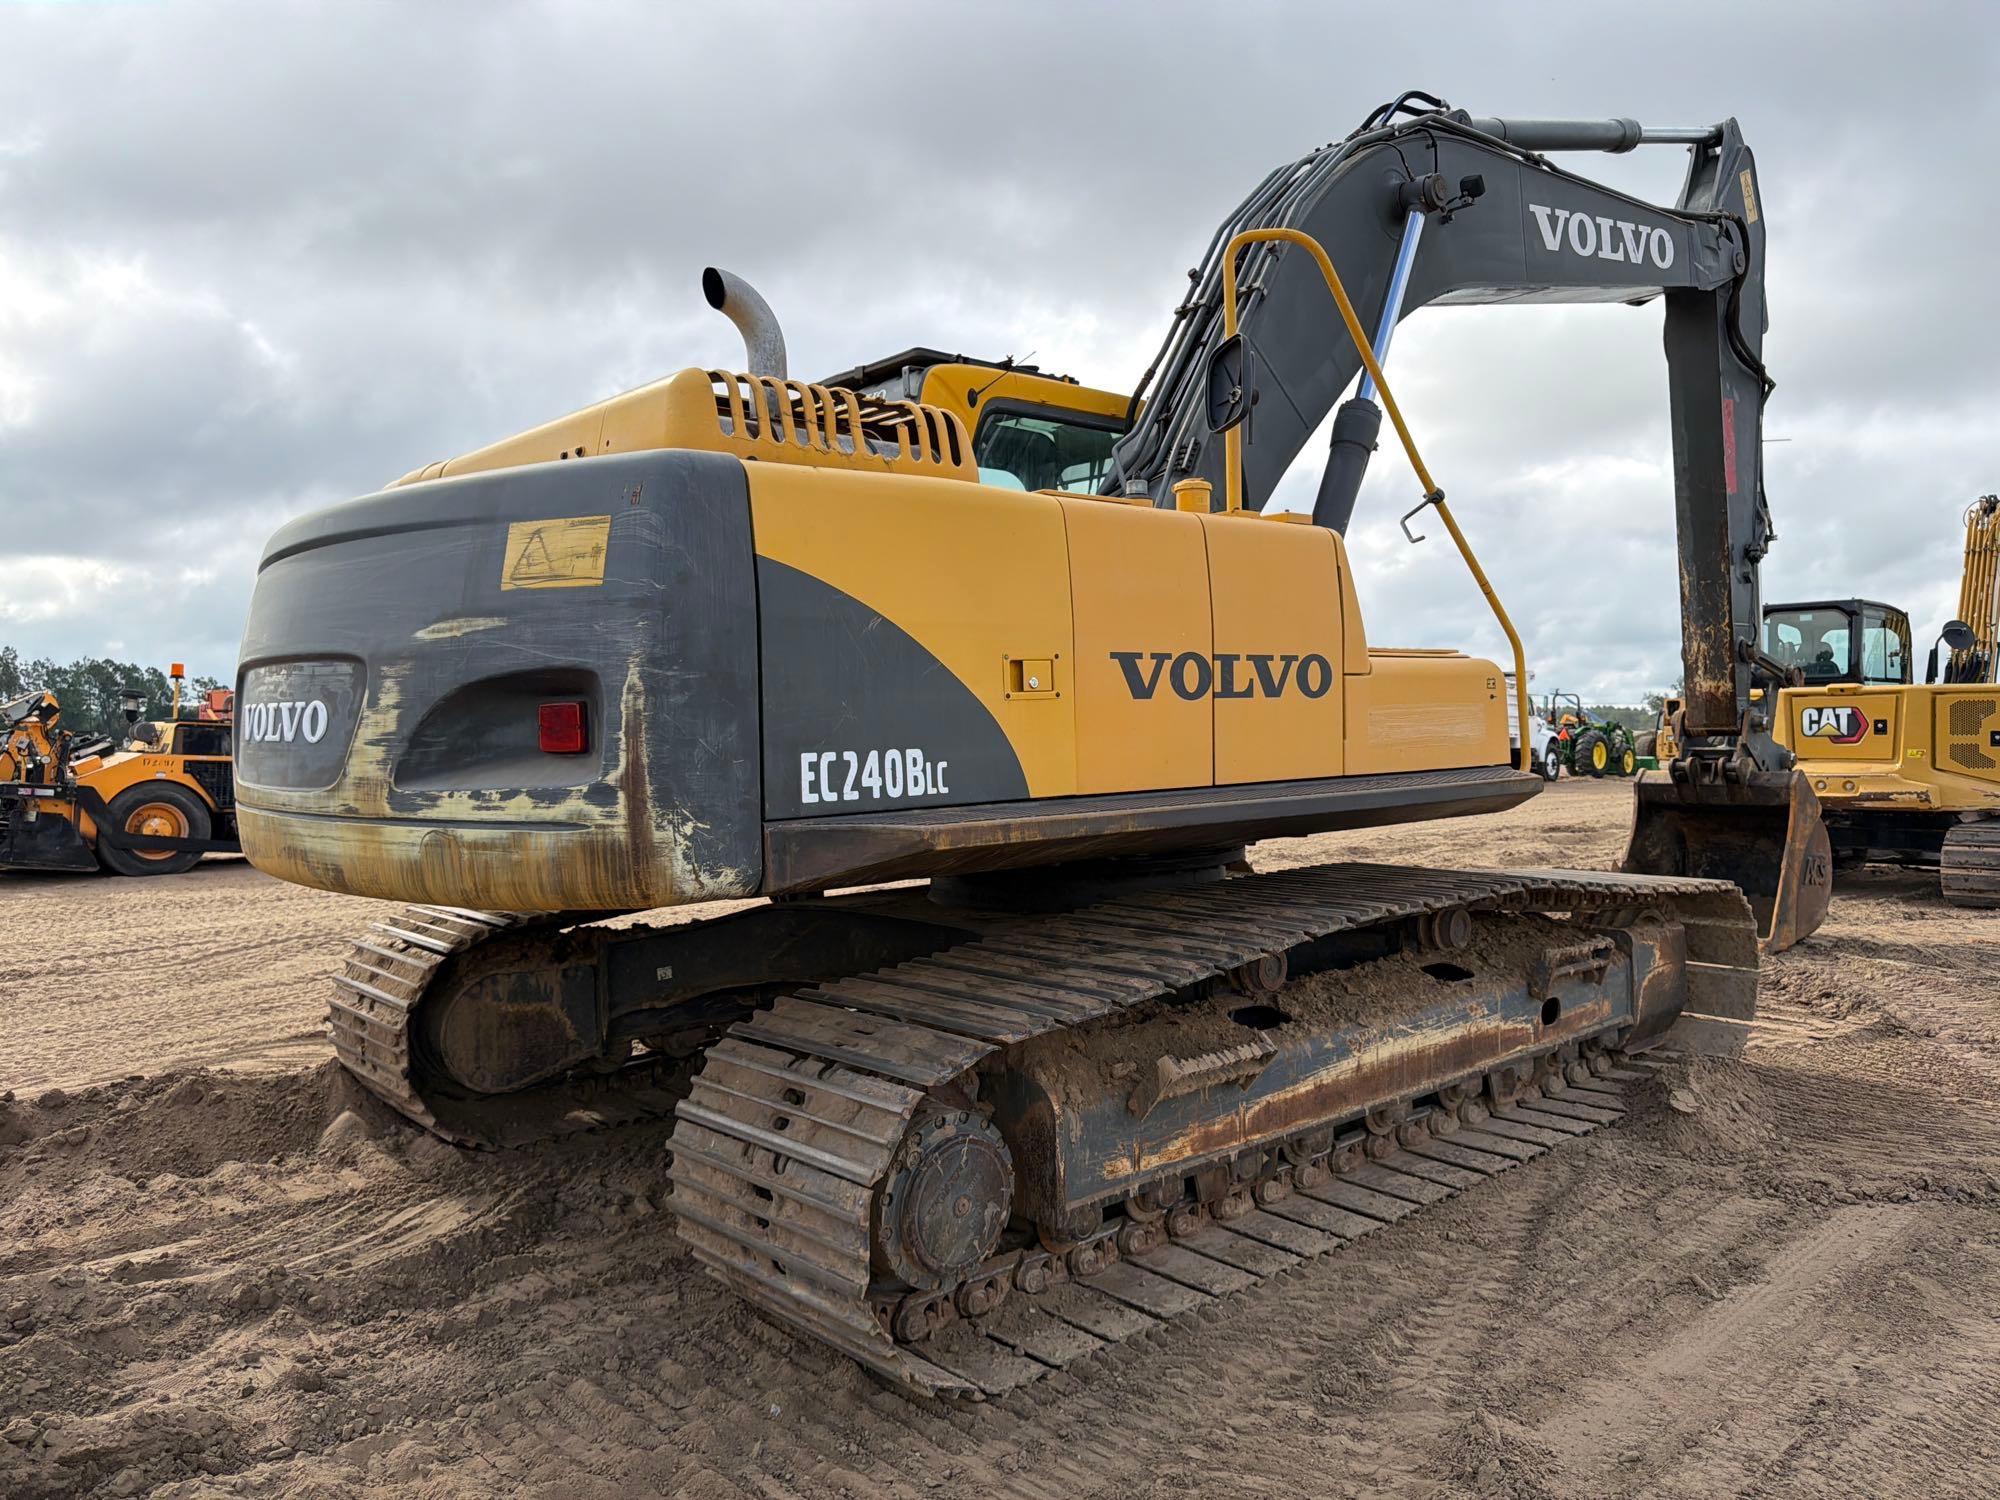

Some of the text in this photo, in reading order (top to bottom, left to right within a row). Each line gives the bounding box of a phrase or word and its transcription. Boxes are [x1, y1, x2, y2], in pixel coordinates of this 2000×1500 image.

[1528, 204, 1674, 270] VOLVO
[1109, 651, 1333, 701] VOLVO
[244, 700, 328, 744] VOLVO
[1802, 707, 1852, 737] CAT
